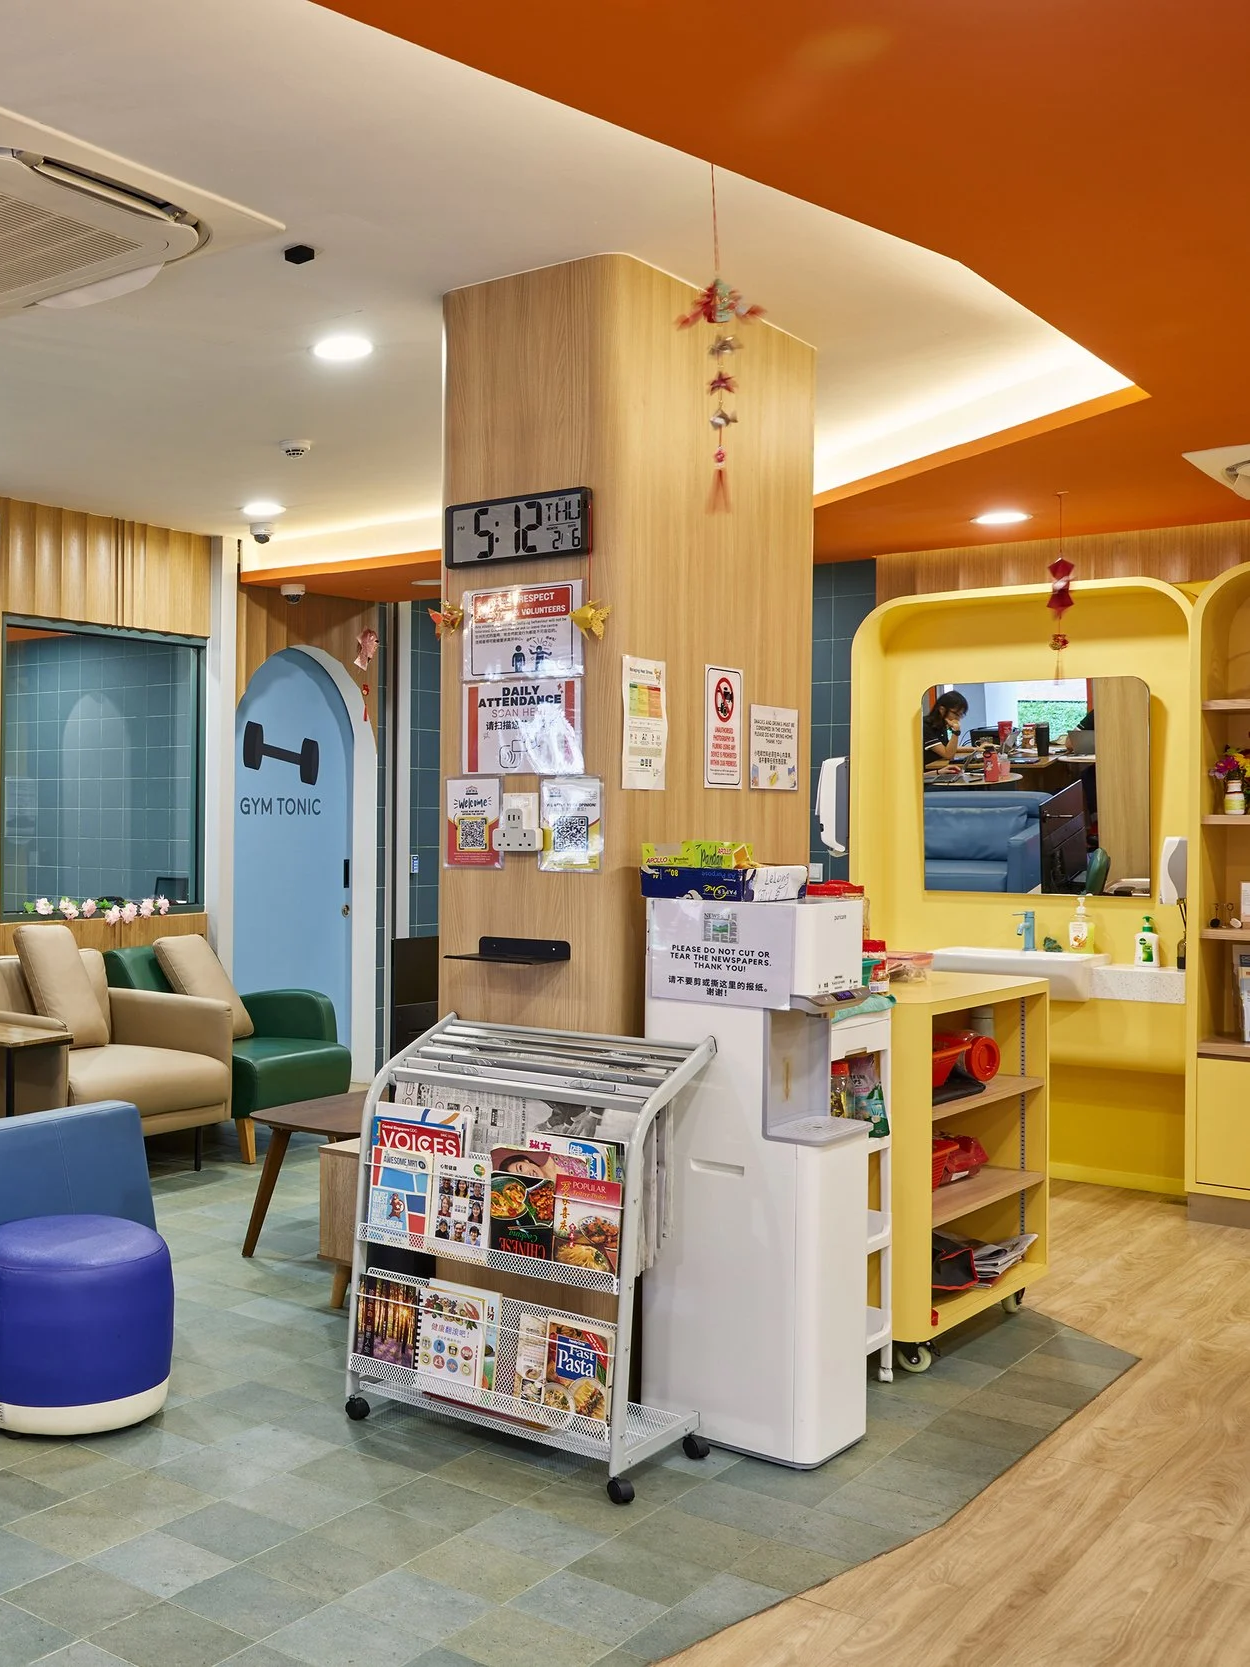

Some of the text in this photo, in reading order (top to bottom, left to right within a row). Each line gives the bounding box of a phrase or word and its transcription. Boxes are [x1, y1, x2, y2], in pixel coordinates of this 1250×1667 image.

[546, 499, 581, 522] THU
[474, 500, 543, 559] 5:12
[518, 592, 555, 604] RESPECT
[521, 605, 566, 616] VOLUNTEERS
[502, 685, 540, 697] DAILY
[478, 694, 562, 708] ATTENDANCE
[491, 708, 519, 719] SCAN
[240, 797, 322, 816] GYM TONIC
[458, 798, 488, 809] Welcome
[672, 945, 702, 953] PLEASE
[738, 949, 754, 957] CUT
[670, 952, 772, 967] TEAR THE NEWSPAPERS.
[694, 962, 746, 972] THANK YOU!
[668, 975, 768, 993] 请不要剪或撕这里的报纸。
[382, 1130, 457, 1157] VOICES
[383, 1155, 407, 1165] AWESOME
[572, 1181, 607, 1194] POPULAR
[499, 1237, 547, 1260] CHINESE
[569, 1346, 595, 1361] Fast
[557, 1349, 595, 1378] Pasta
